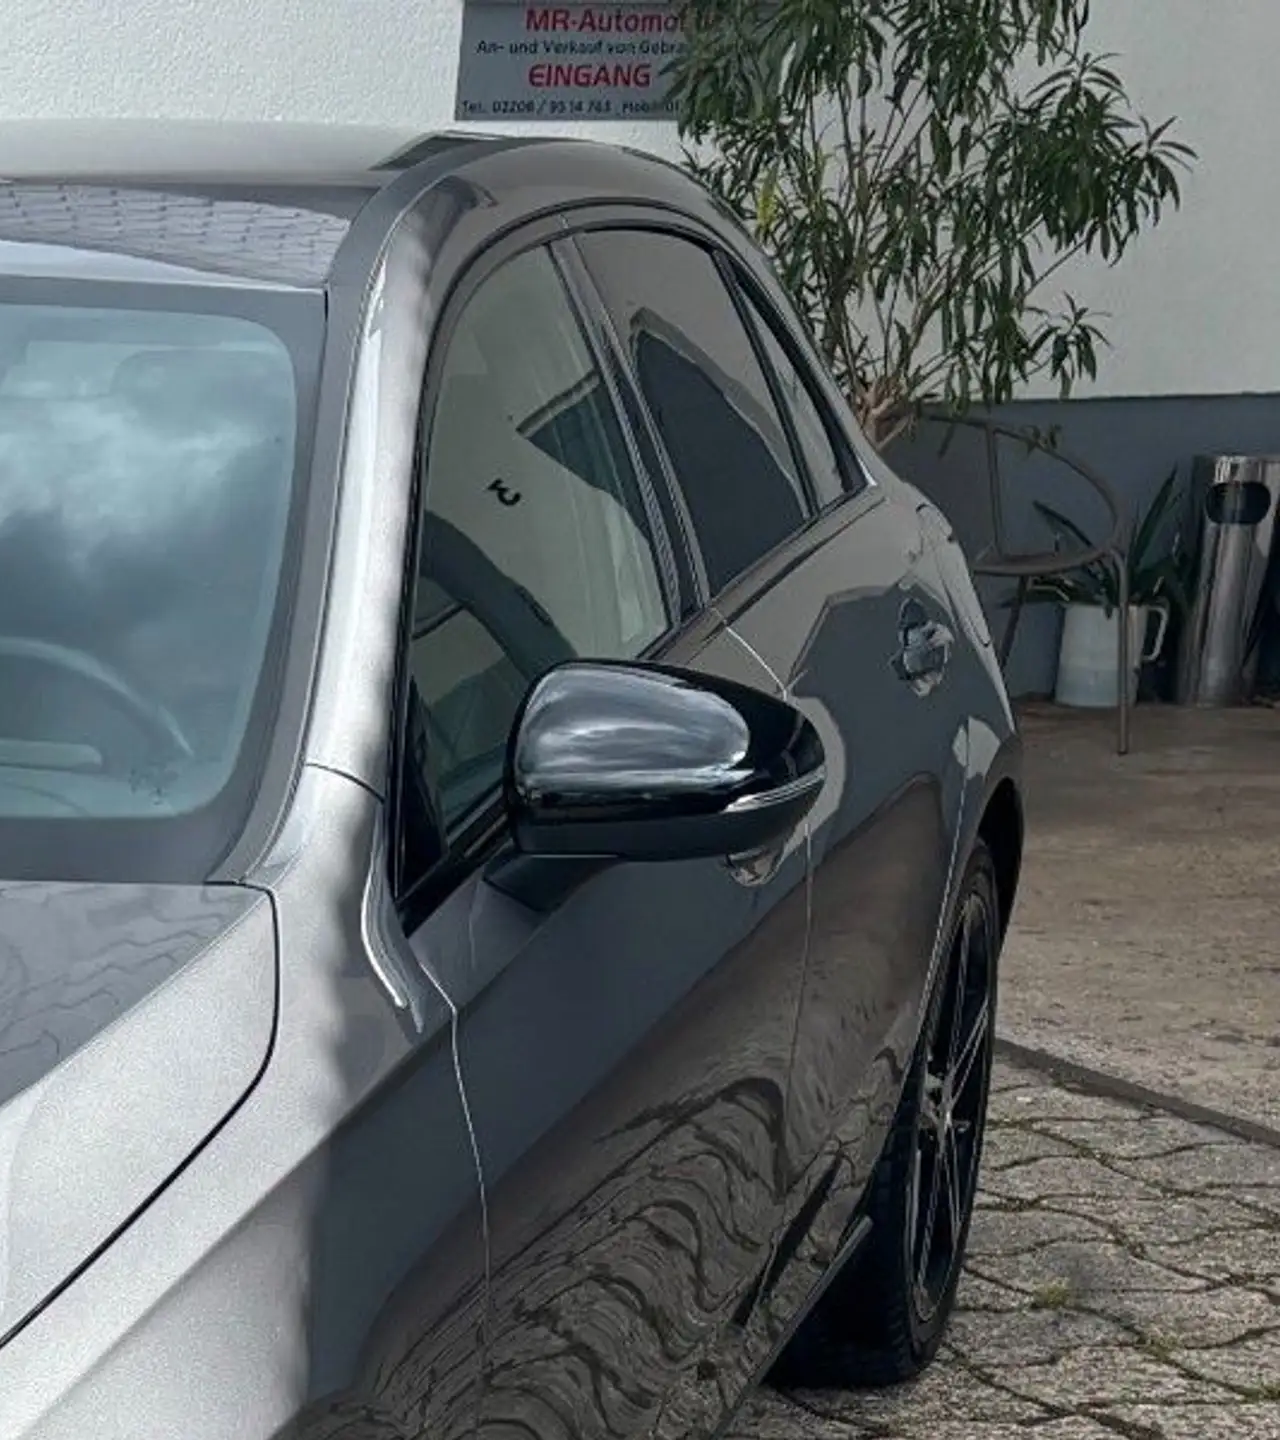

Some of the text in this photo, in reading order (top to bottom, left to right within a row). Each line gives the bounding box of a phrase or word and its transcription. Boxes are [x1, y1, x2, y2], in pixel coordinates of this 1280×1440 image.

[526, 8, 684, 32] MR-Automo
[510, 40, 537, 54] und
[543, 40, 602, 54] Verkauf
[529, 63, 652, 88] EINGANG
